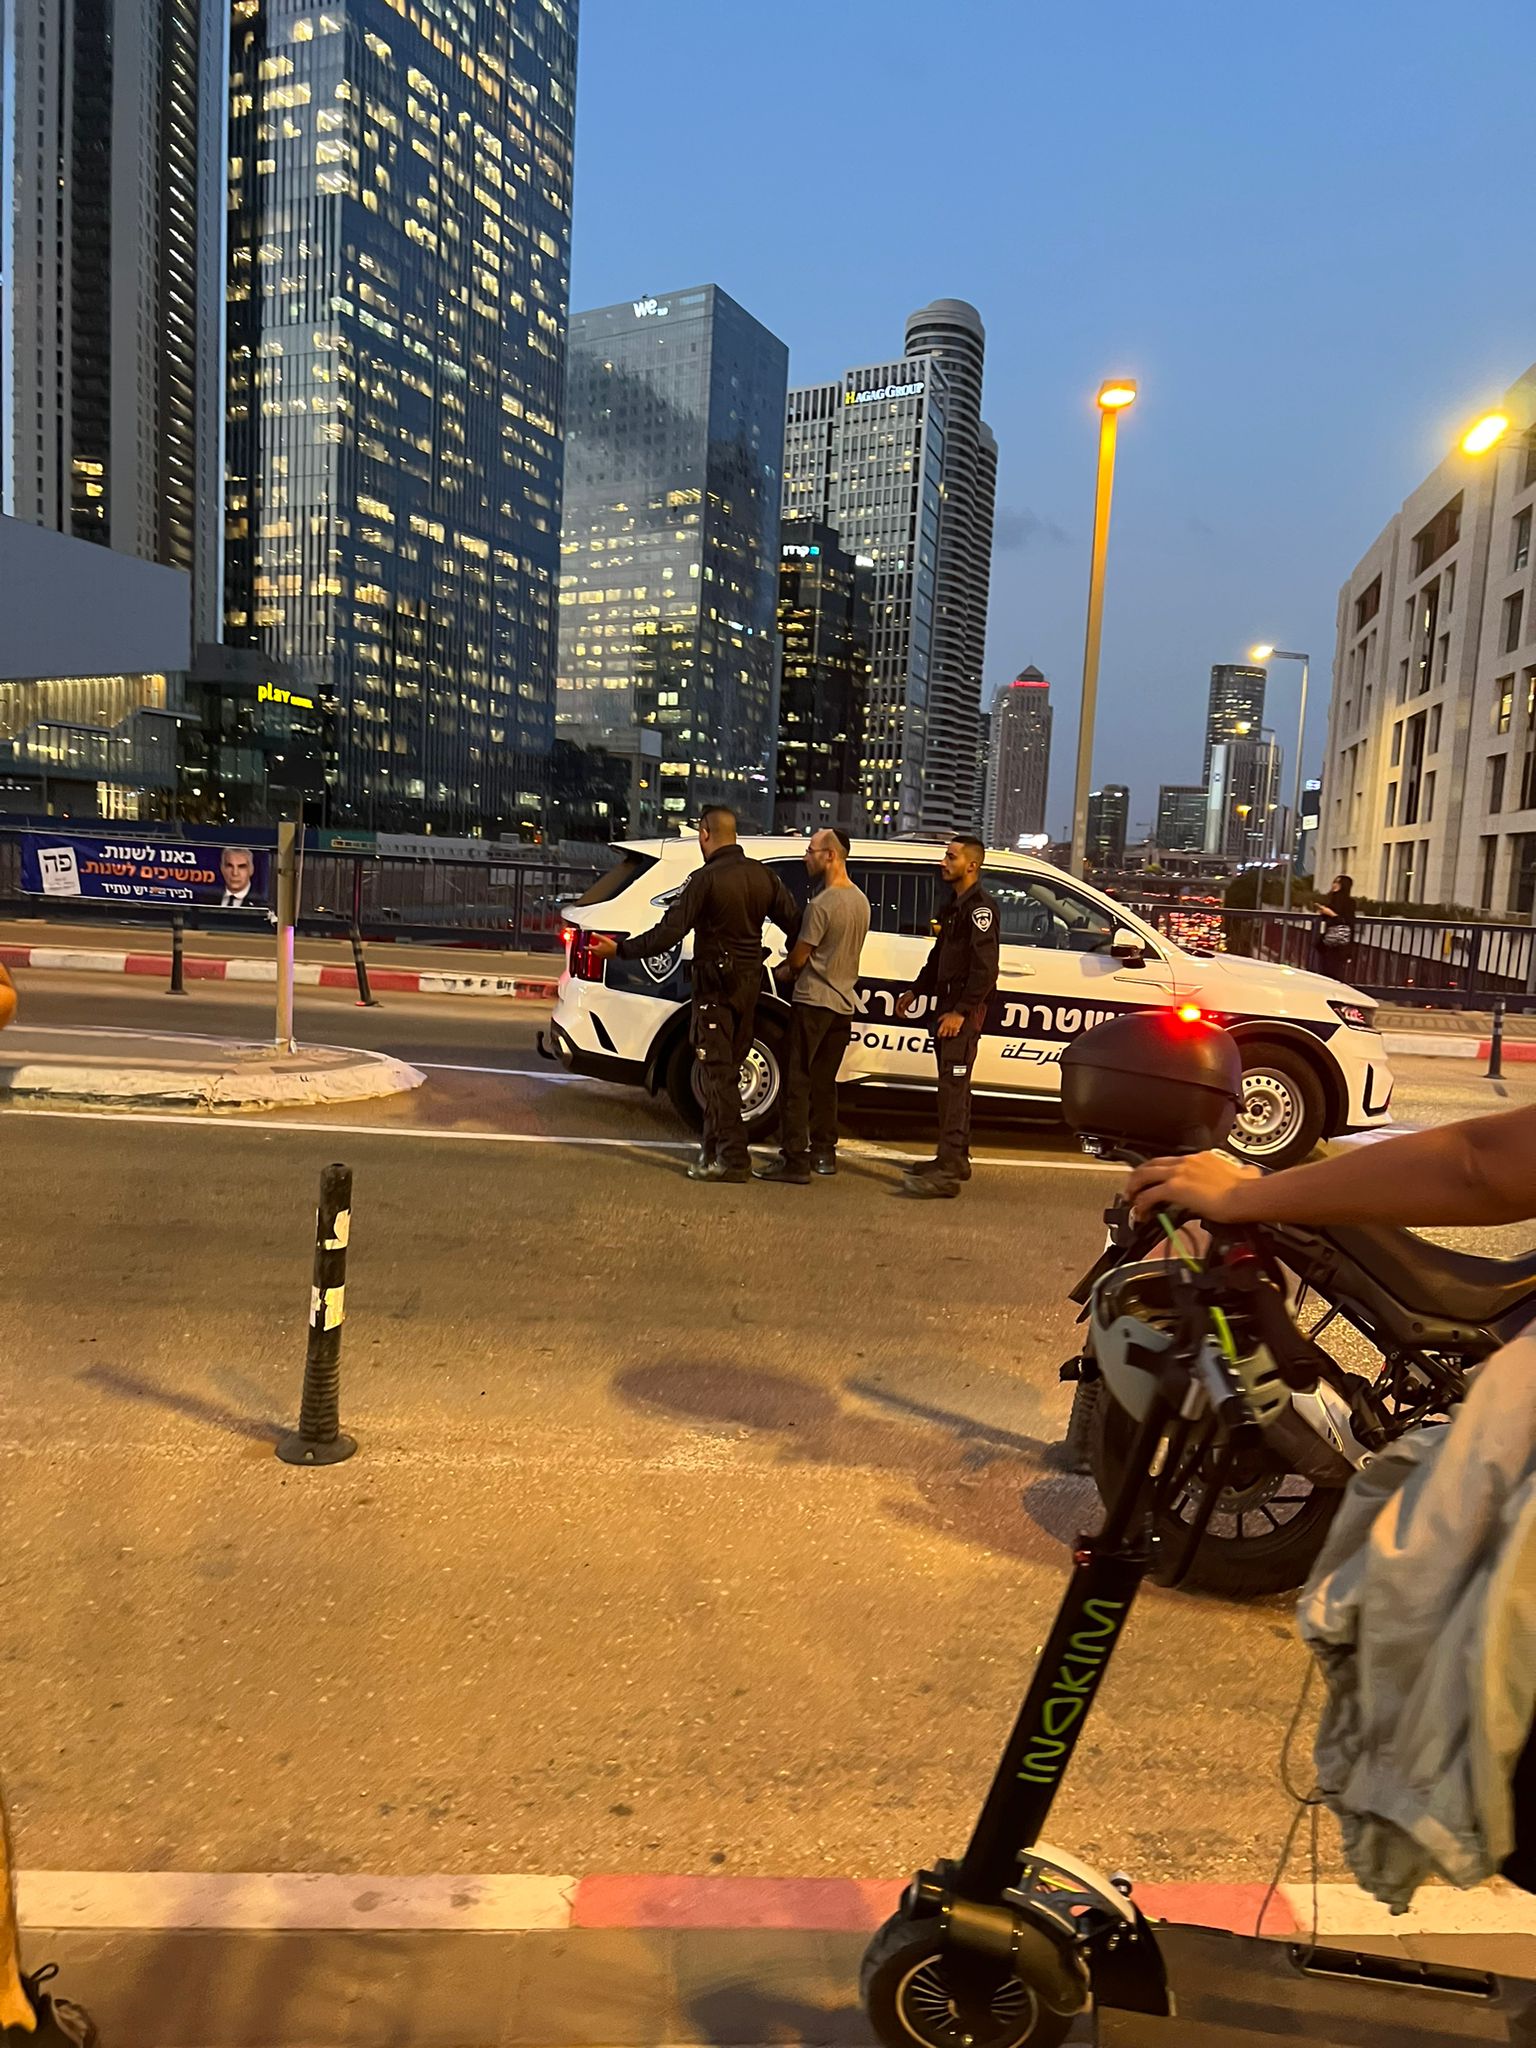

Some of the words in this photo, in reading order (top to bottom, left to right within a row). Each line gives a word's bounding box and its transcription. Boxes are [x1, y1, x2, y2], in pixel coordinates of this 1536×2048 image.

[98, 845, 156, 862] לשנות.
[160, 849, 197, 865] באנו
[43, 854, 72, 874] פה
[140, 865, 216, 883] ממשיכים
[101, 882, 131, 895] עתיד
[133, 885, 148, 896] יש
[166, 887, 194, 899] לפיד
[850, 1031, 935, 1054] POLICE
[1016, 1598, 1125, 1784] INOKIM
